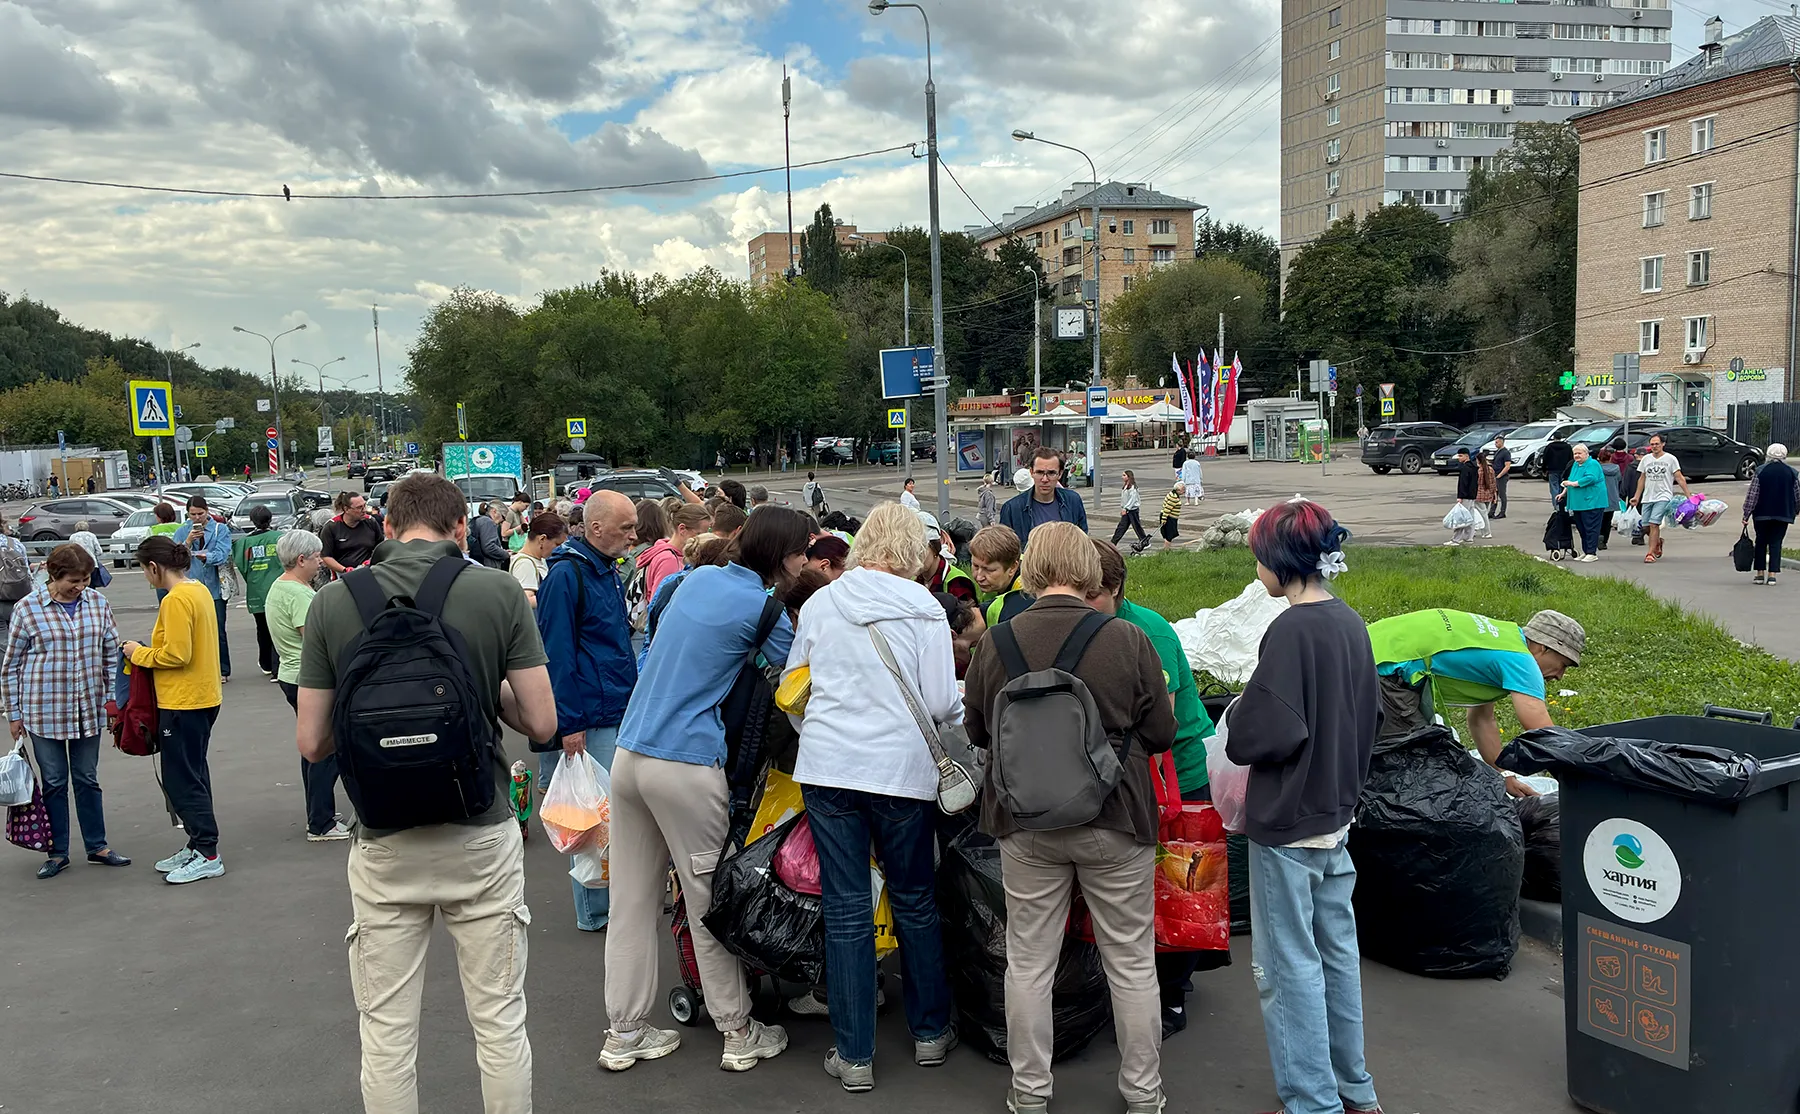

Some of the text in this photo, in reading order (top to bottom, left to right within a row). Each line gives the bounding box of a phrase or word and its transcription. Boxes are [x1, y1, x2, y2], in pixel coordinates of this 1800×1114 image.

[1585, 374, 1632, 386] АПТЕ
[1132, 395, 1154, 404] КАФЕ
[1602, 868, 1658, 892] хартия
[1586, 926, 1681, 960] СМЕШАННЫЕ ОТХОДЫ
